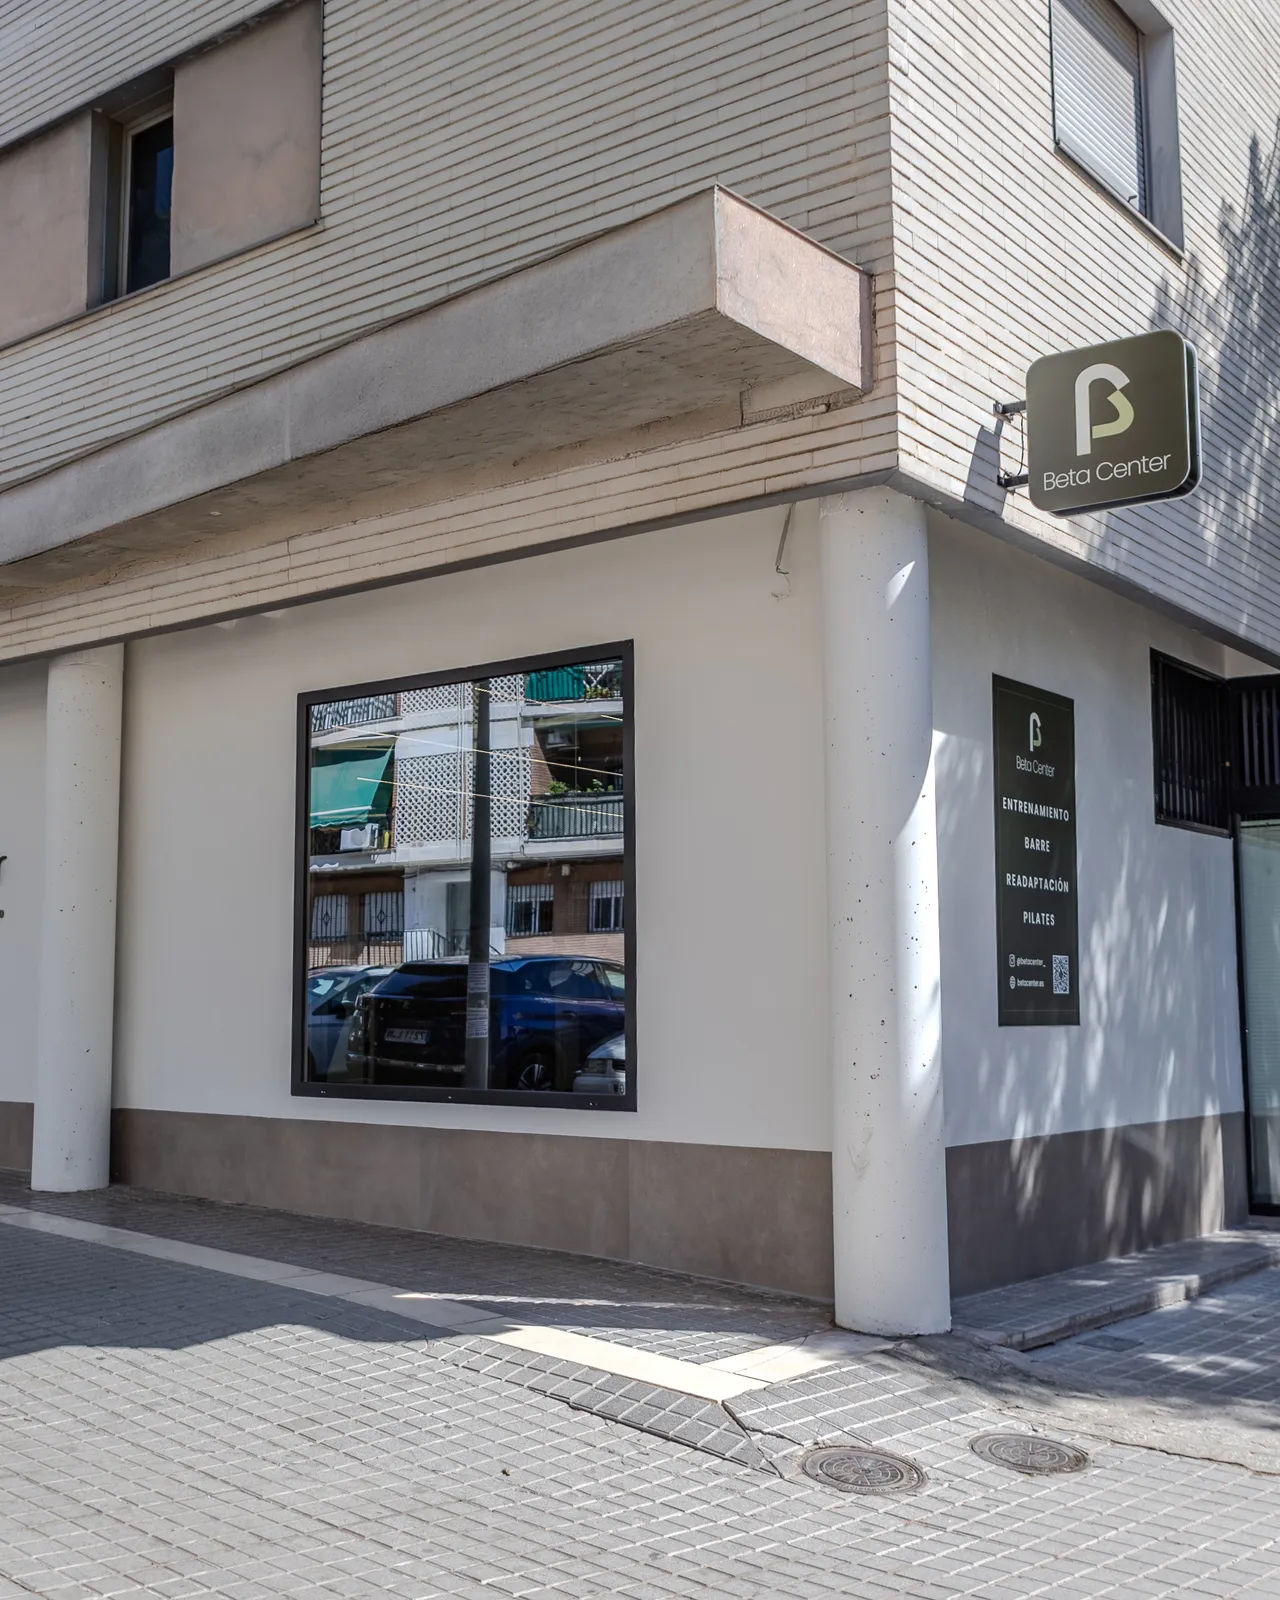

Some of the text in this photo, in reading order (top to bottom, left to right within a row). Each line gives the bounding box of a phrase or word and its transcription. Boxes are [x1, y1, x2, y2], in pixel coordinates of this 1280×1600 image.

[1043, 453, 1172, 492] Beta Center
[1015, 754, 1056, 778] Beta Center
[1002, 796, 1070, 821] ENTRENAMIENTO
[1024, 836, 1050, 853] BARRE
[1006, 872, 1069, 893] READAPTACIÓN
[1023, 910, 1055, 927] PILATES
[1017, 978, 1045, 988] betacenter.es
